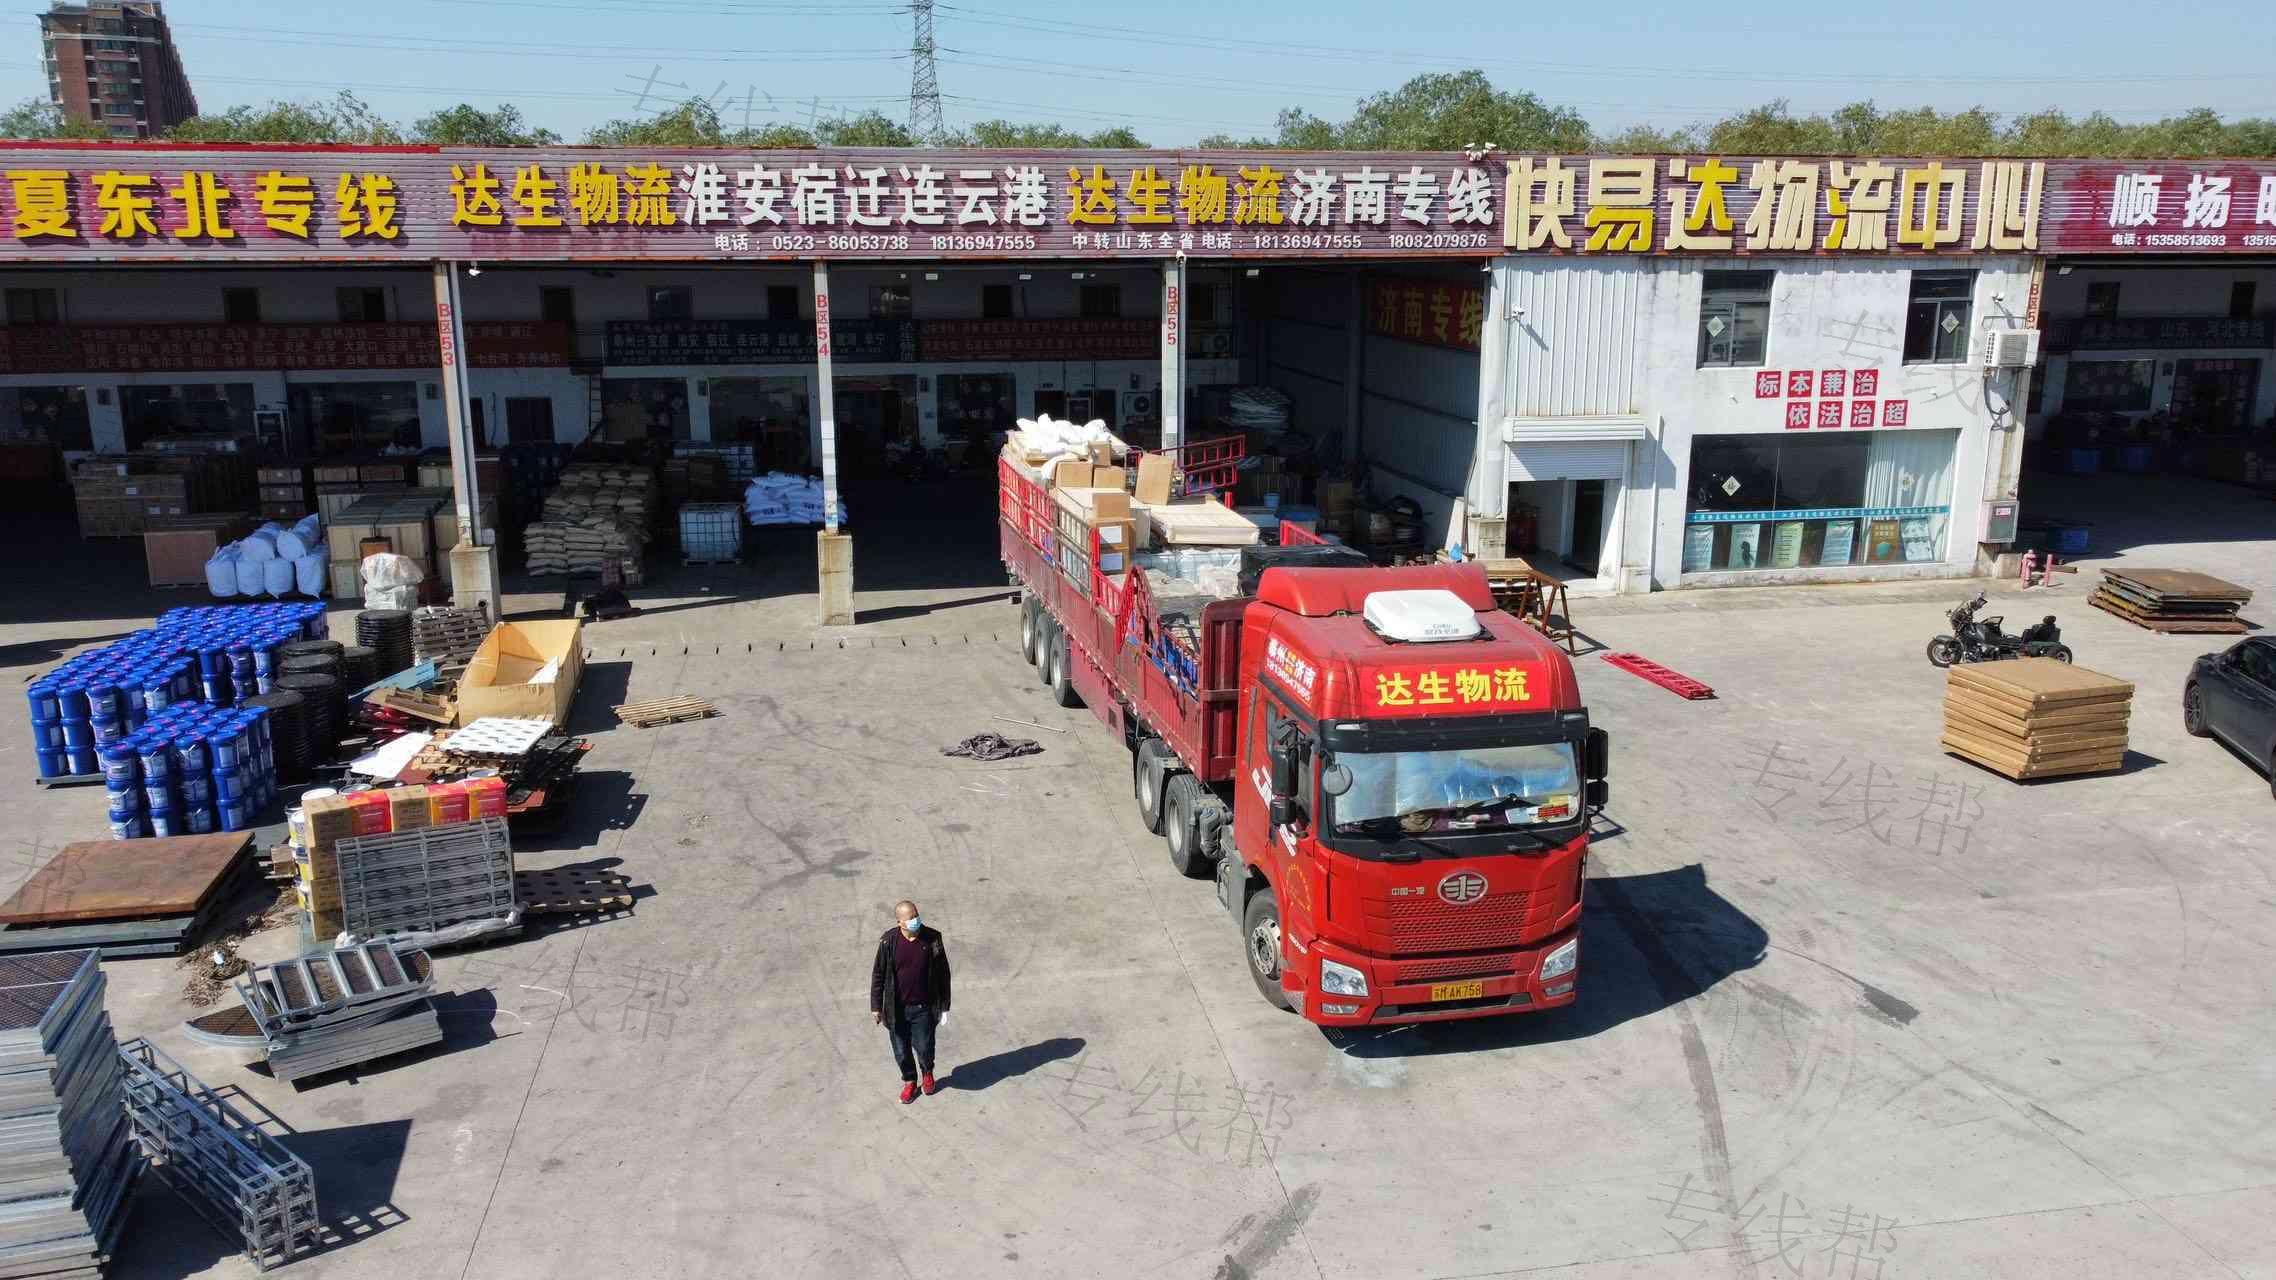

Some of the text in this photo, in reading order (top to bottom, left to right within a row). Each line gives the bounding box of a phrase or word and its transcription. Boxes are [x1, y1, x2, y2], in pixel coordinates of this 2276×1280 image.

[5, 169, 399, 239] 夏东北专线
[1503, 156, 2046, 251] 快易达物流中心
[929, 234, 1035, 251] 18136947555
[1253, 233, 1362, 250] 18136947555
[1388, 233, 1488, 249] 18082079876
[2145, 234, 2226, 247] 15358513693
[1376, 287, 1482, 345] 济南专线
[1756, 370, 1878, 398] 标本兼治
[1788, 401, 1907, 428] 依法治超
[1376, 667, 1531, 708] 达生物流
